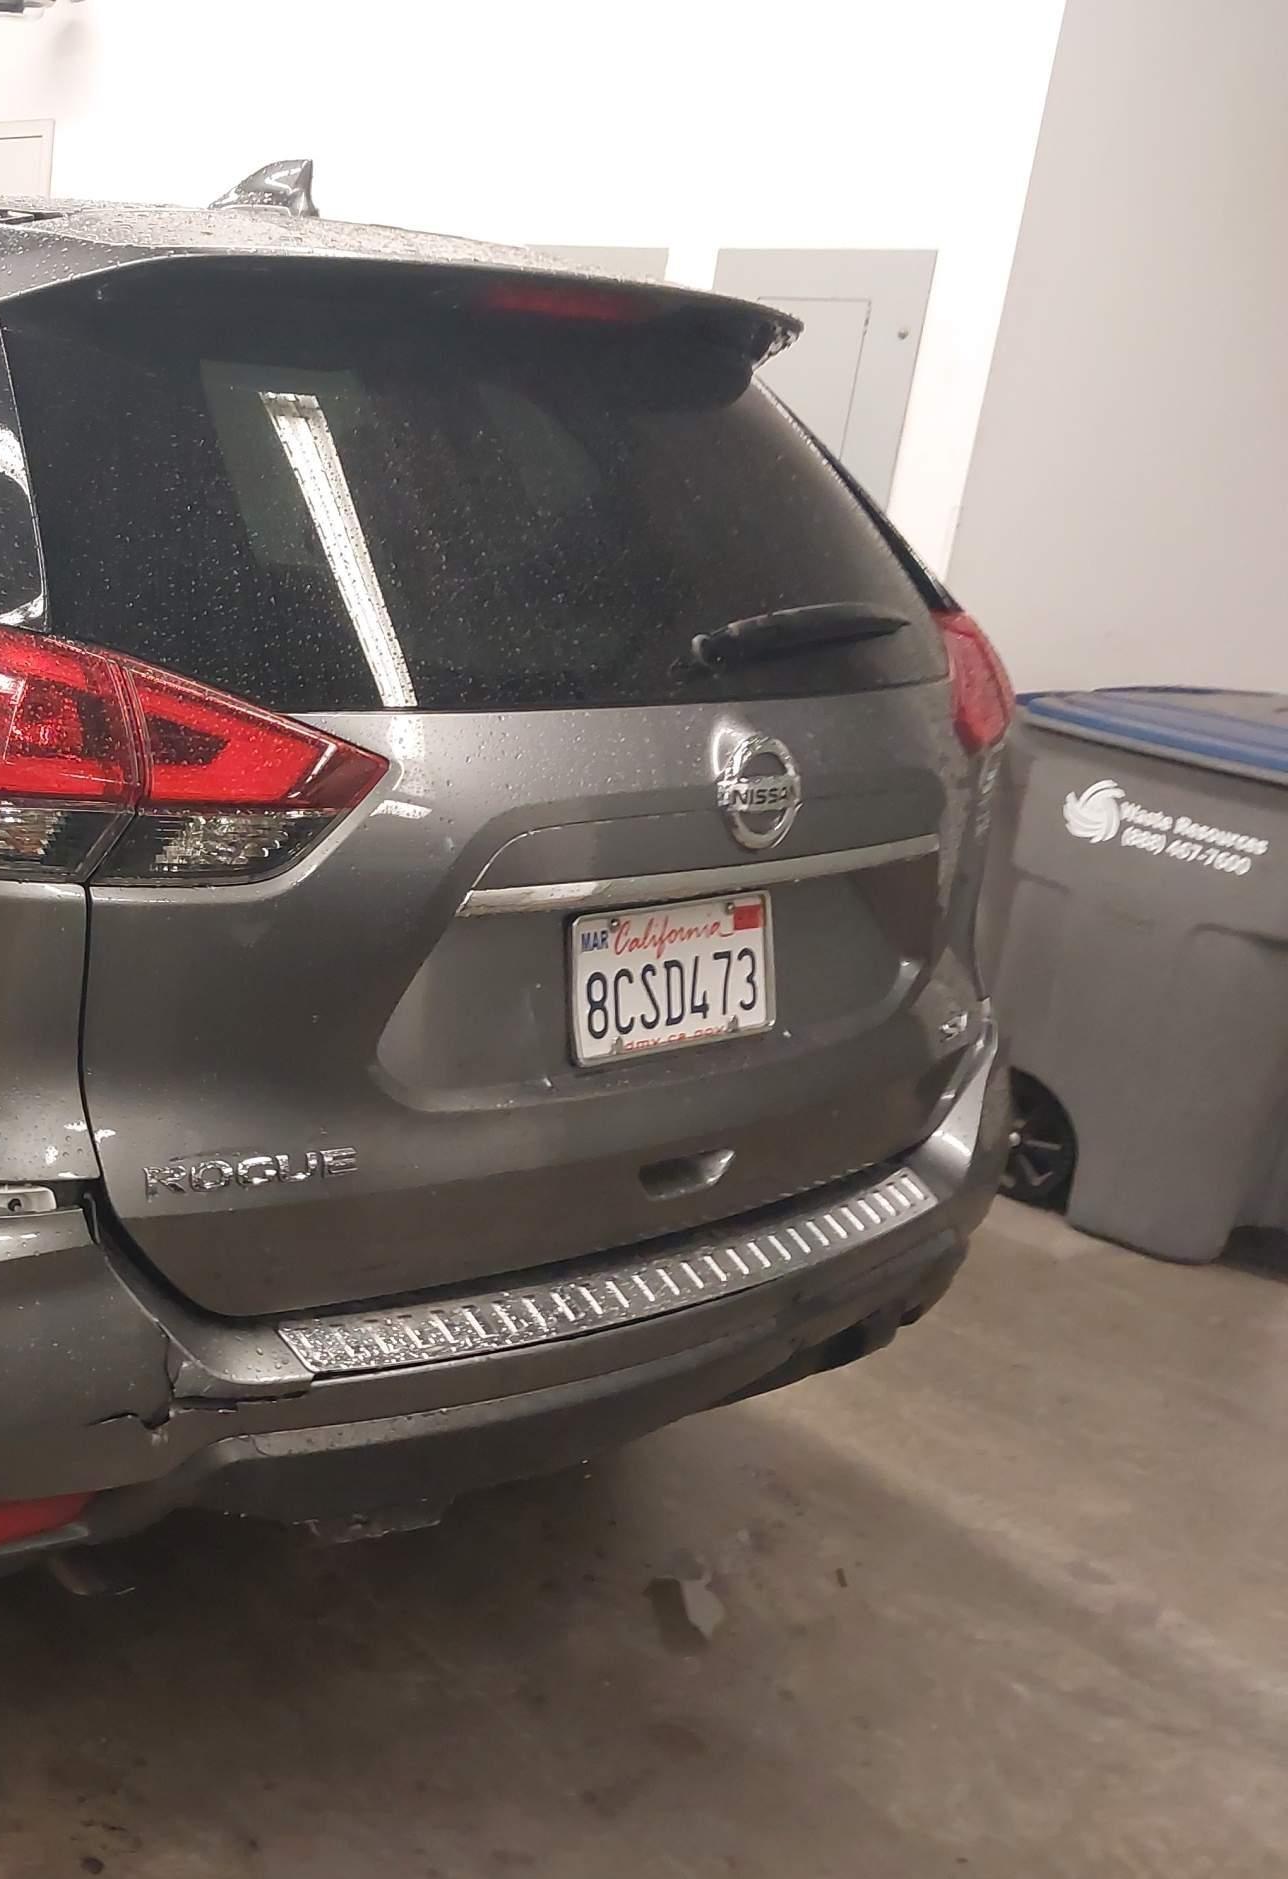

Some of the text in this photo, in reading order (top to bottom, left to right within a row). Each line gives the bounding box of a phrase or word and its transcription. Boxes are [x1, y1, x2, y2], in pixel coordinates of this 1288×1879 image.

[581, 930, 609, 952] MAR
[614, 914, 733, 958] California
[586, 947, 758, 1040] 8CSD473
[143, 1147, 359, 1202] ROGUE
